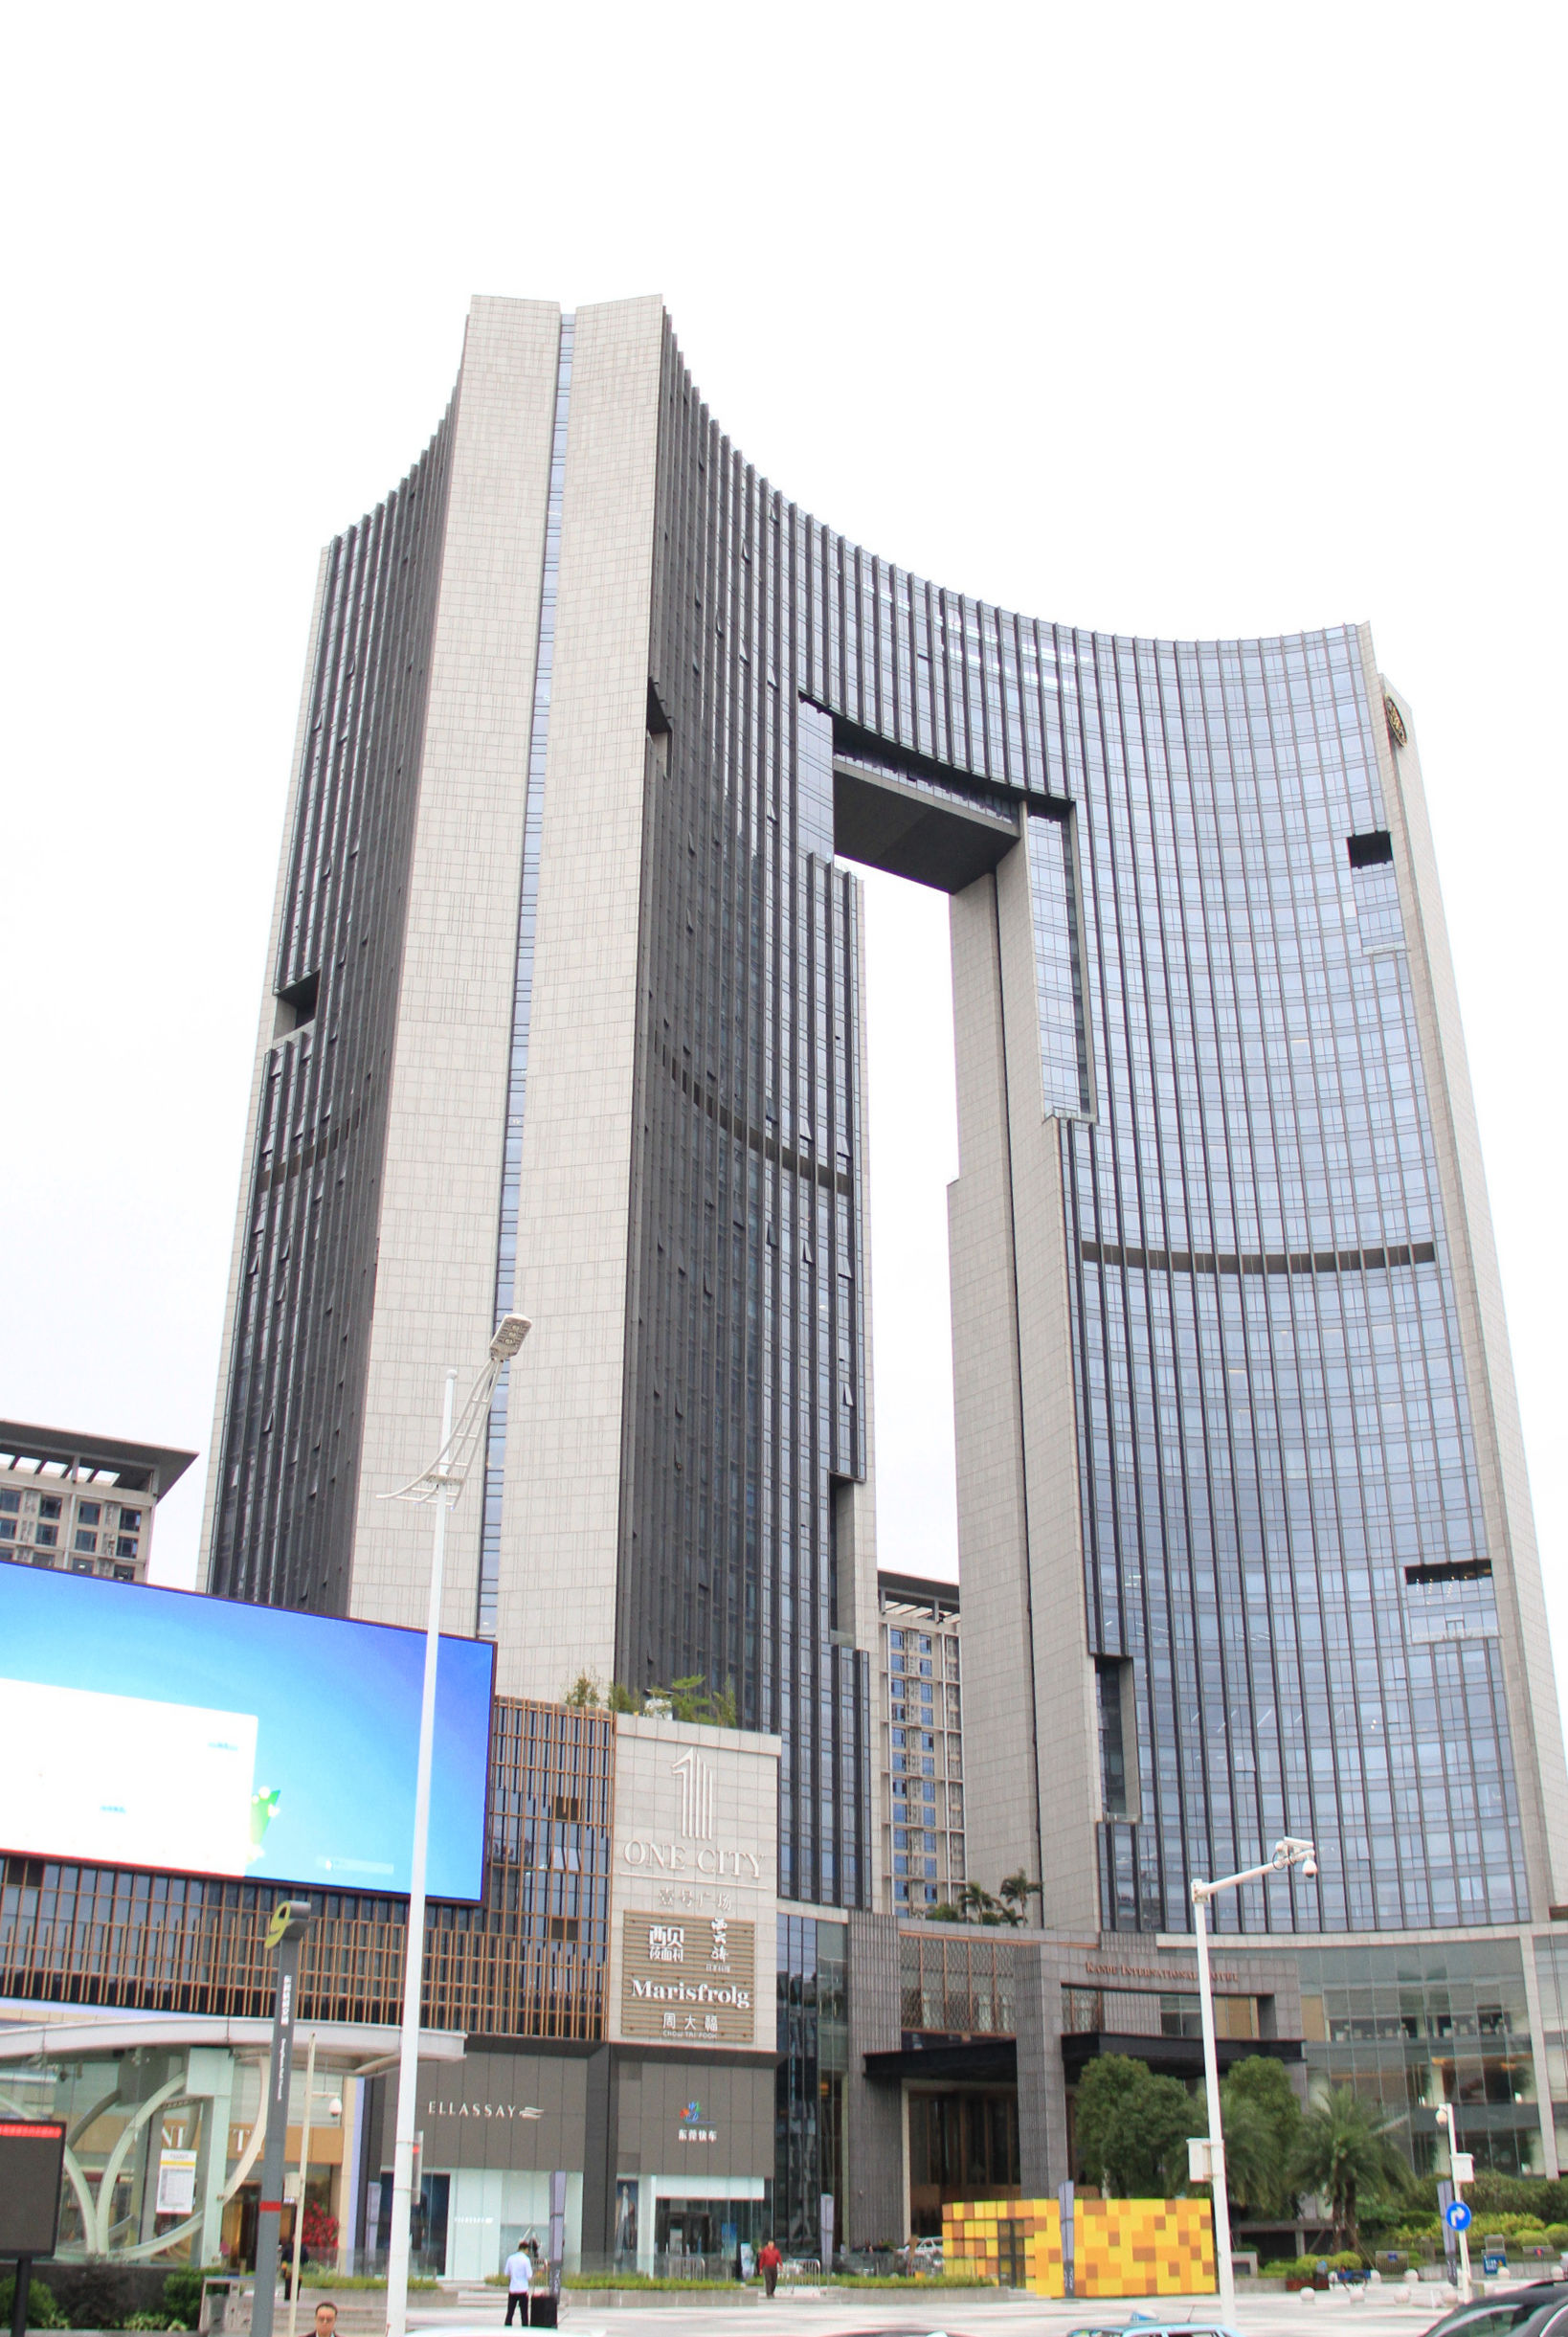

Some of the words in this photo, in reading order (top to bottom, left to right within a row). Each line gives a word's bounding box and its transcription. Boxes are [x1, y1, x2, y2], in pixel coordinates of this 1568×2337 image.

[624, 1839, 686, 1870] ONE
[697, 1847, 766, 1878] CITY
[649, 1924, 684, 1948] 西贝
[1211, 1970, 1239, 1983] OTEL
[632, 1979, 750, 2010] Marisfrolg
[662, 2012, 718, 2032] 周大福
[428, 2101, 517, 2120] ELLASSAY
